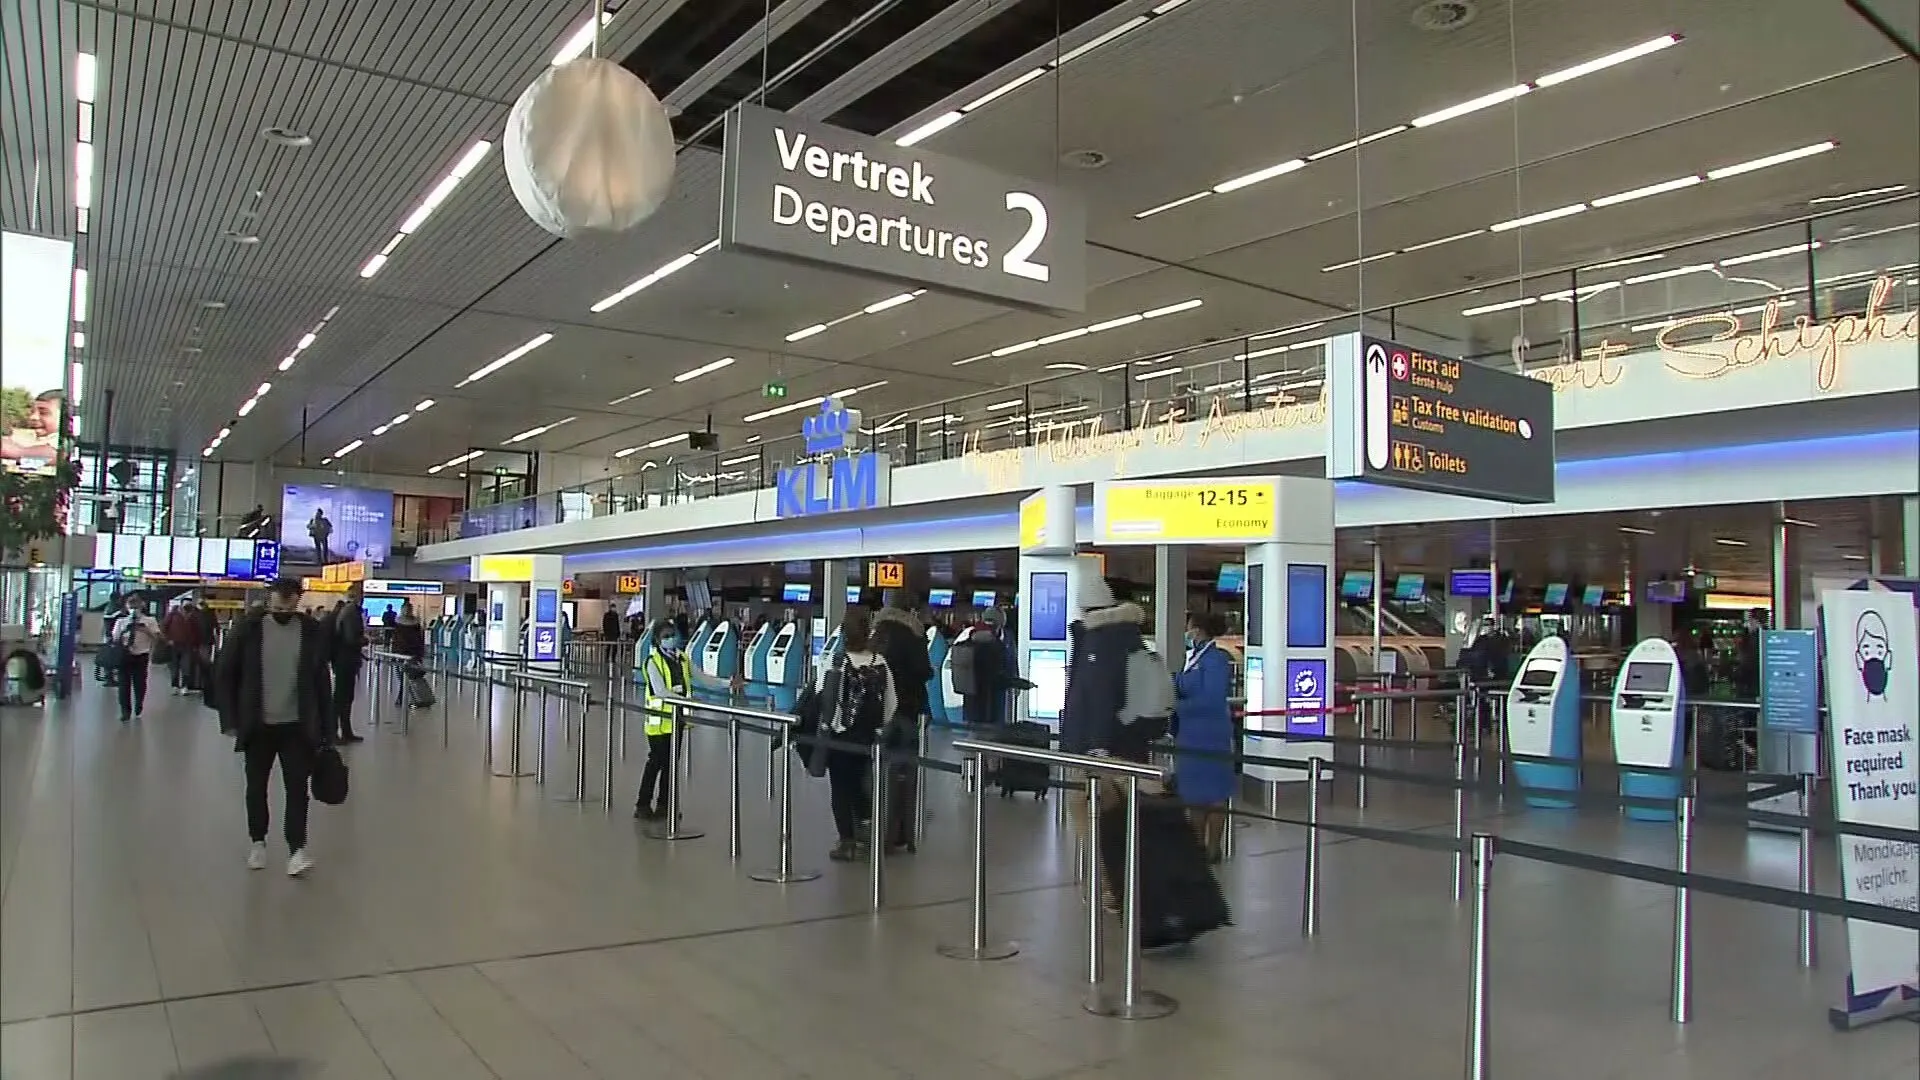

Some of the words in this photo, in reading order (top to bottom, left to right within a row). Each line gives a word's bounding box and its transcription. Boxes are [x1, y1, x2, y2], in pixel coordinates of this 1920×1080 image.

[774, 127, 934, 205] Vertrek
[772, 184, 989, 268] Departures
[1002, 191, 1049, 282] 2
[1411, 351, 1438, 375] First
[1441, 360, 1460, 379] aid
[1411, 395, 1432, 416] Tax
[1436, 400, 1460, 421] free
[1462, 409, 1517, 433] validation
[1412, 417, 1444, 434] Customs
[1427, 451, 1467, 473] Toilets
[776, 452, 877, 517] KLM
[1198, 489, 1248, 506] 12-15
[1216, 518, 1269, 529] Economy
[625, 577, 637, 588] 15
[882, 565, 899, 580] 14
[1844, 728, 1874, 746] Face
[1877, 724, 1911, 743] mask
[1846, 751, 1903, 777] required
[1848, 779, 1890, 802] Thank
[1892, 781, 1917, 801] you
